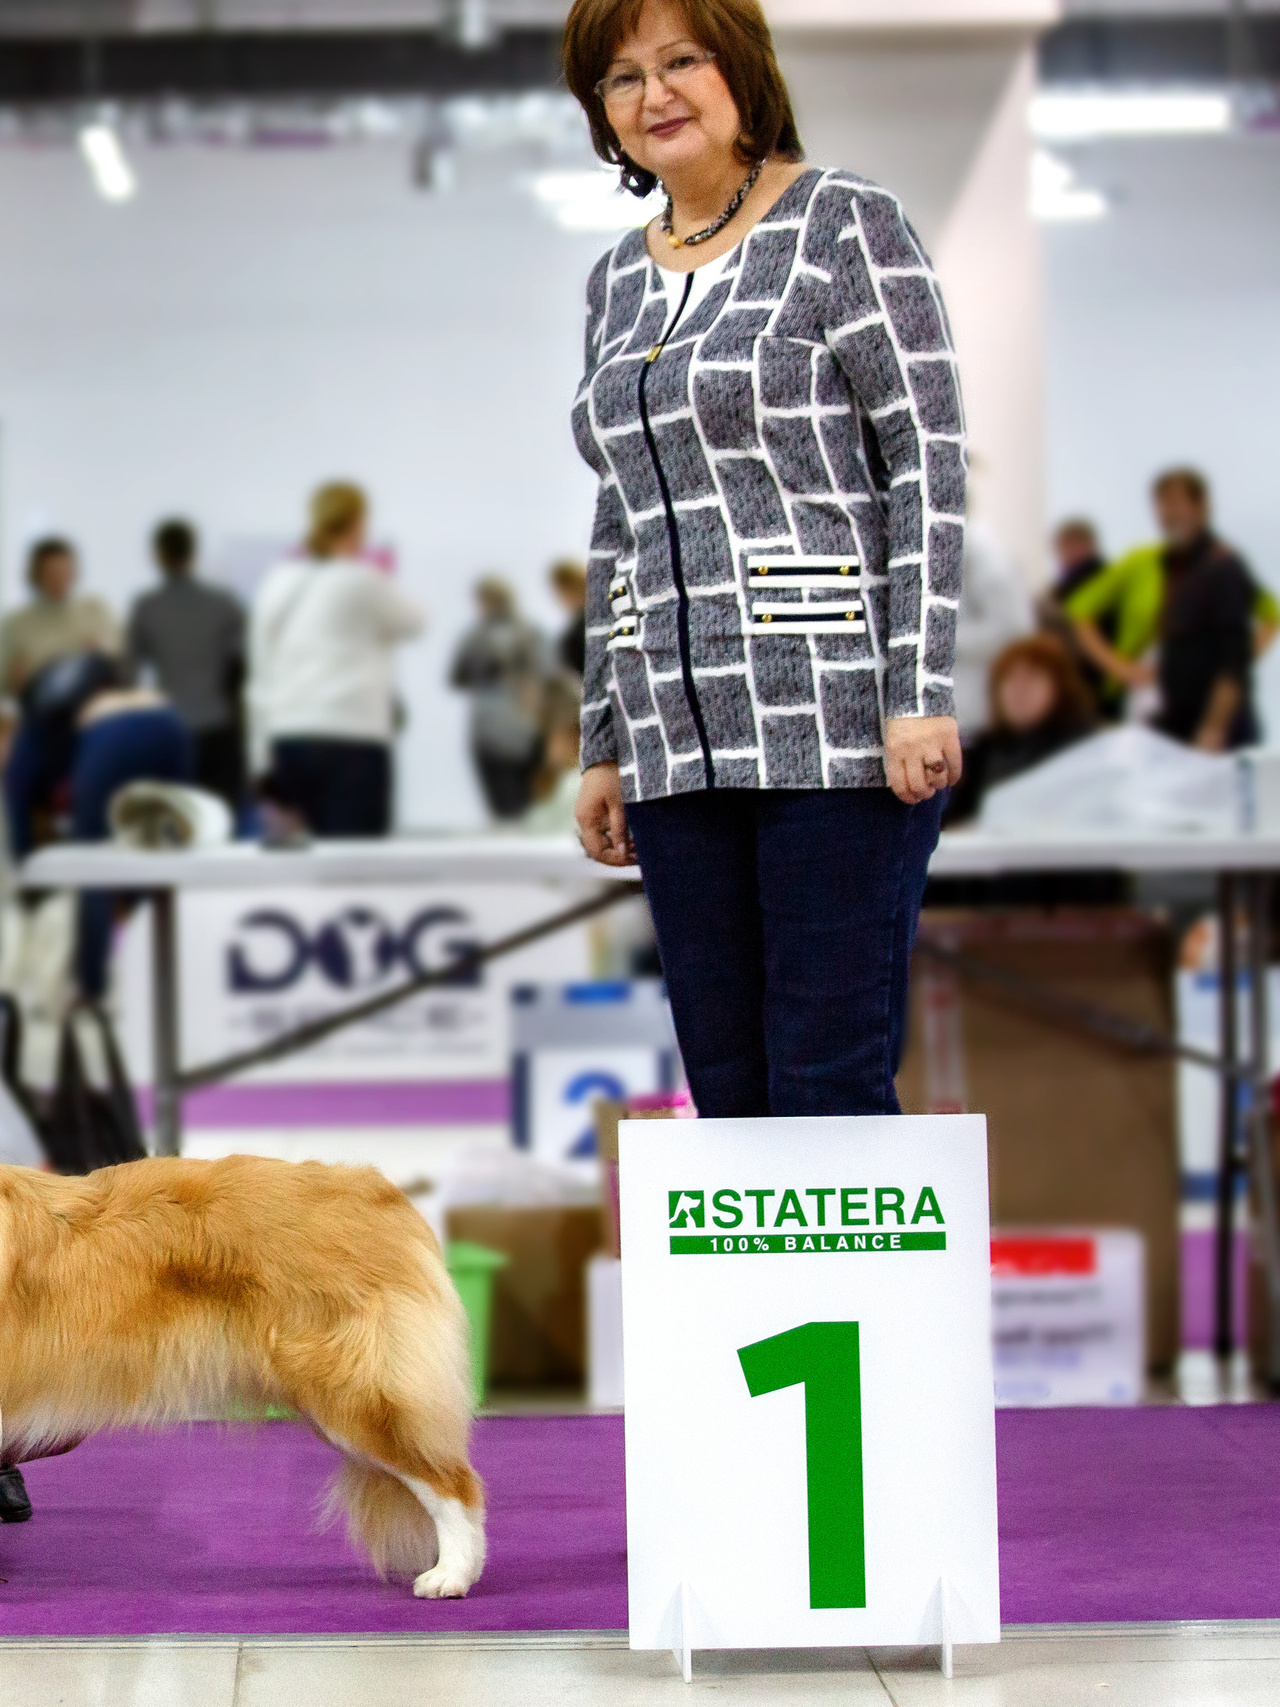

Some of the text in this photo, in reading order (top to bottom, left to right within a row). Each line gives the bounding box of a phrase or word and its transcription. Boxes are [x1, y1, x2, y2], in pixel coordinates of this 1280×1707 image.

[712, 1187, 945, 1228] STATERA
[710, 1233, 902, 1252] 100% BALANCE
[737, 1321, 866, 1609] 1
